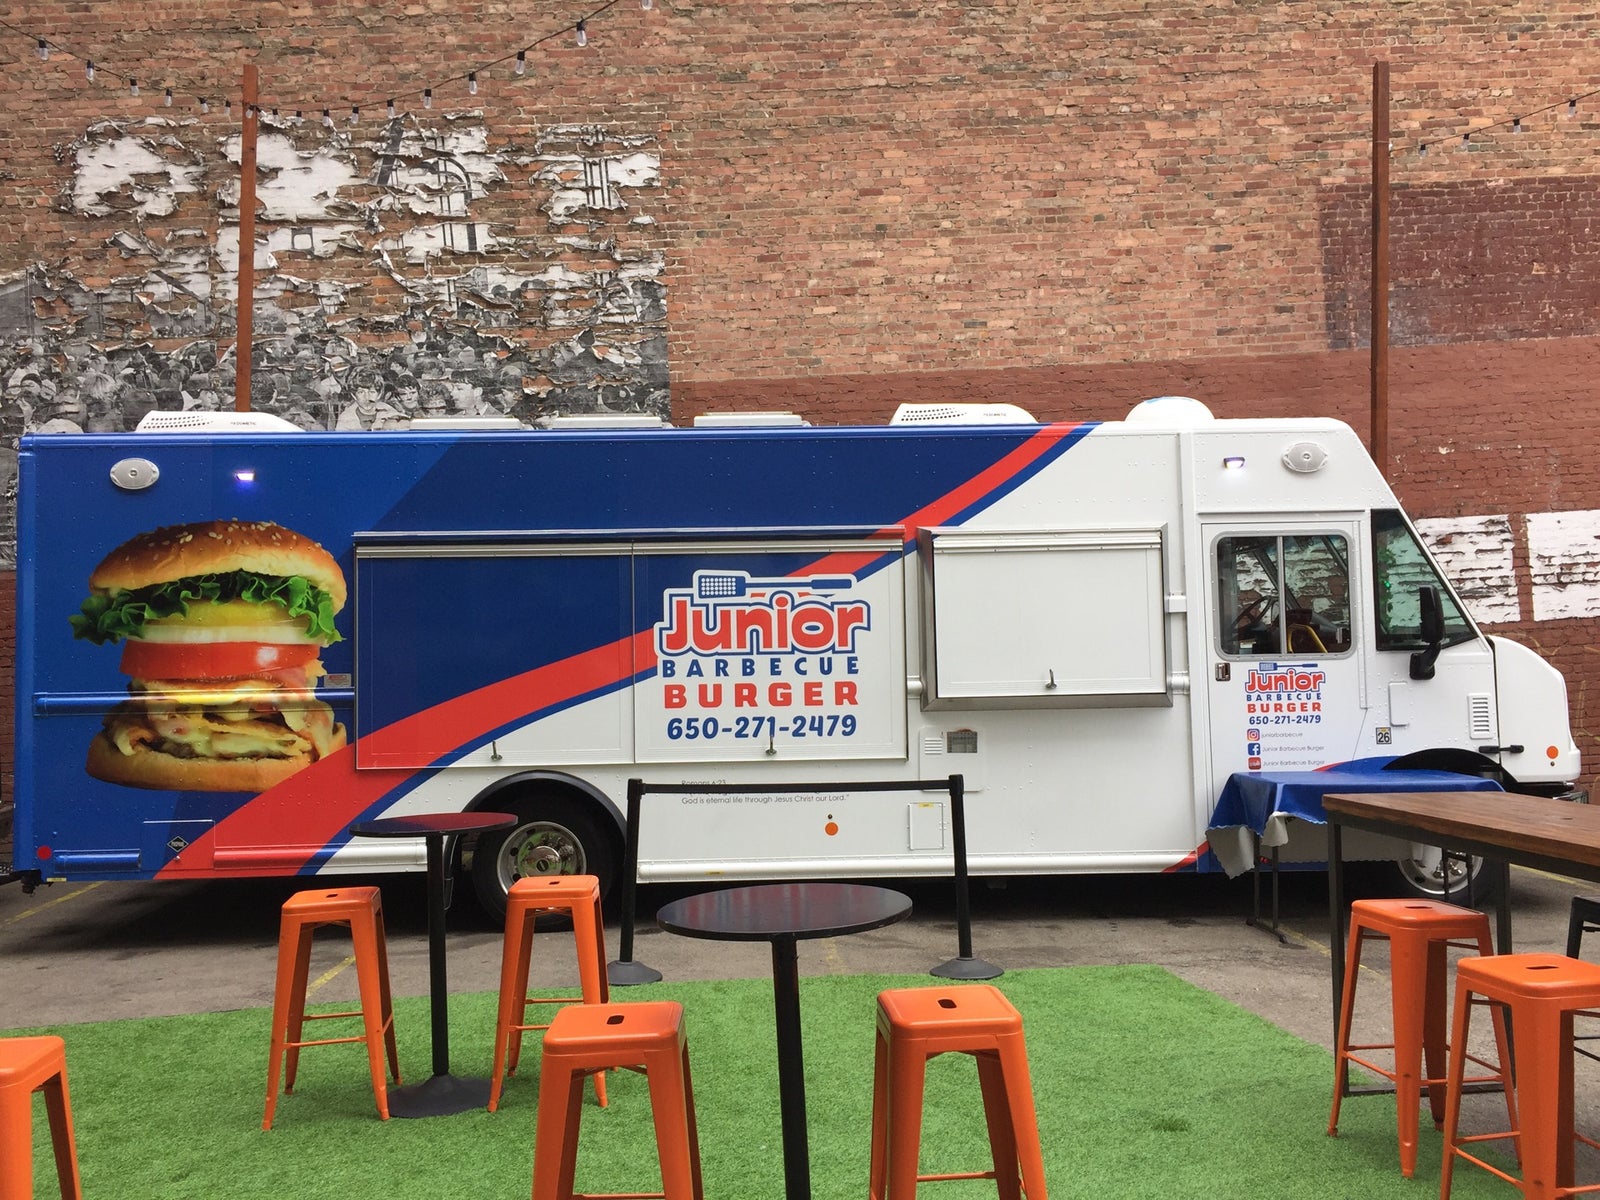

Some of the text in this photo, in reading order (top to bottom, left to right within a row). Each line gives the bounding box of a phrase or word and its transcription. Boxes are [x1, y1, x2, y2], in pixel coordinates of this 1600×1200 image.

[663, 595, 867, 653] Junior
[662, 656, 859, 678] BARBECUE
[1246, 669, 1324, 692] Junior
[664, 681, 859, 709] BURGER
[1246, 693, 1321, 701] BARBECUE
[1247, 702, 1322, 713] BURGER
[667, 714, 857, 740] 650-271-2479
[1249, 714, 1321, 725] 650-271-2479
[1377, 732, 1390, 743] 26
[744, 796, 772, 804] through
